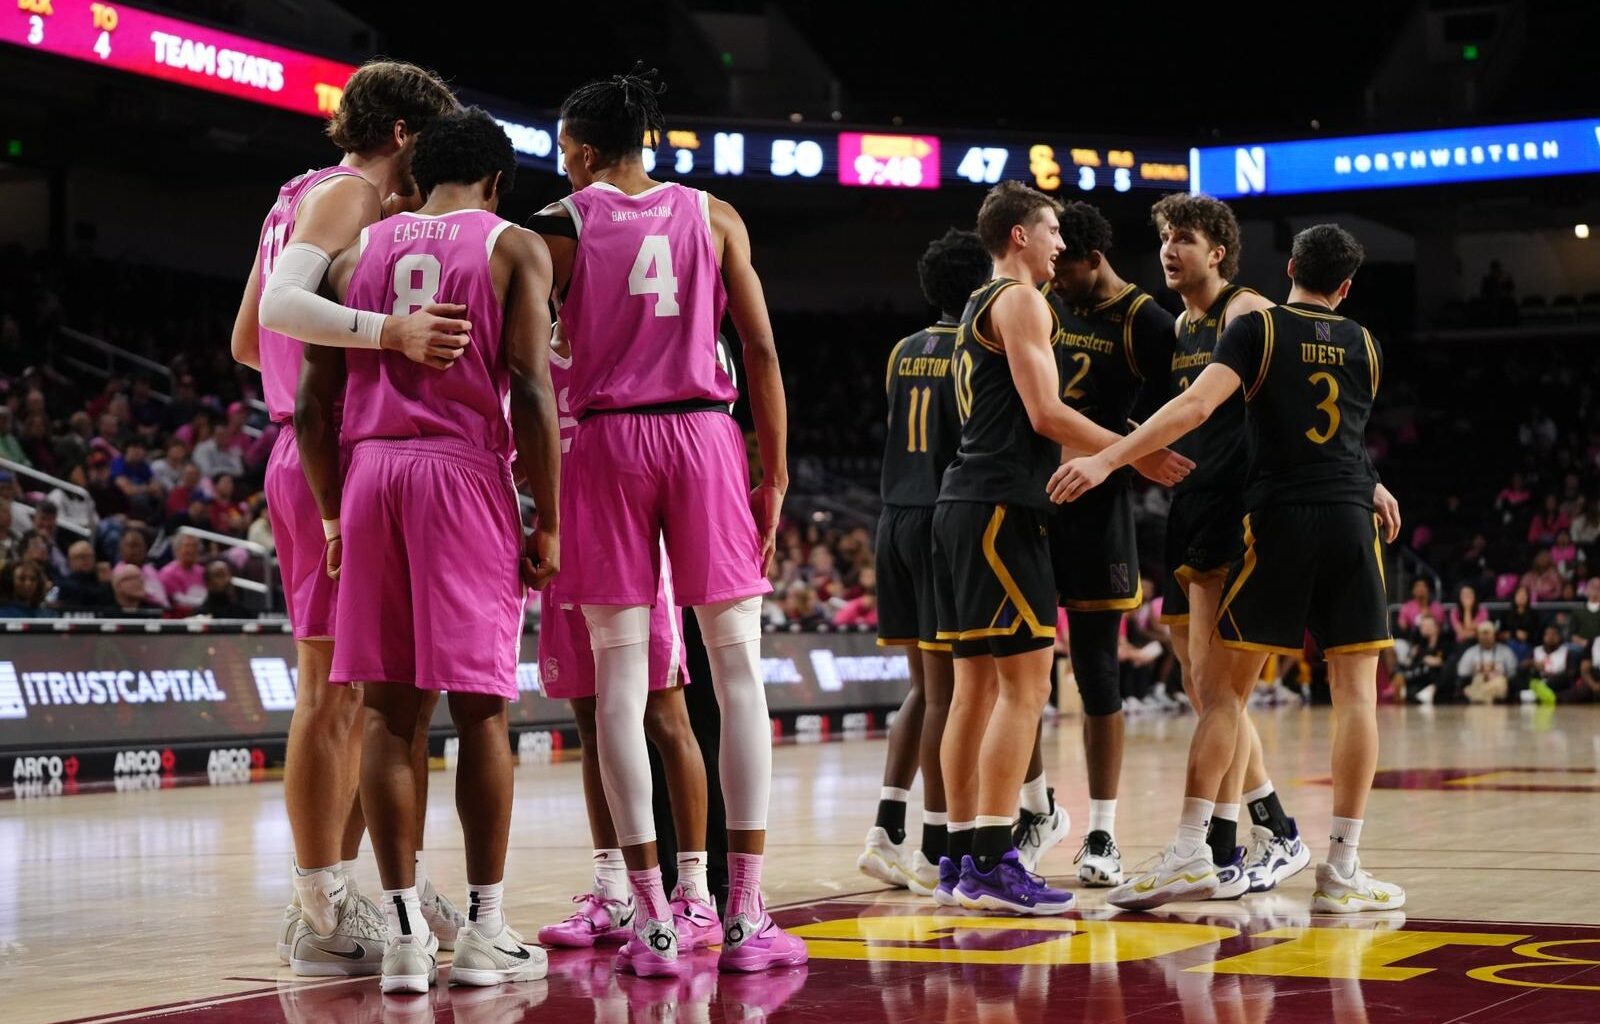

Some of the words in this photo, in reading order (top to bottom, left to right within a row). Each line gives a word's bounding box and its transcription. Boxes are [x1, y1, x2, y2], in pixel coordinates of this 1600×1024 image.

[27, 14, 44, 45] 3
[90, 2, 119, 31] TO
[93, 31, 112, 60] 4
[150, 31, 216, 75] TEAM
[216, 48, 284, 92] STATS
[714, 131, 745, 176] N
[770, 139, 824, 177] 50
[956, 146, 1009, 184] 47
[1234, 146, 1266, 194] N
[1333, 140, 1560, 175] NORTHWESTERN
[1077, 165, 1096, 191] 3
[393, 220, 447, 243] EASTER
[392, 254, 442, 317] 8
[627, 234, 680, 317] 4
[898, 356, 951, 378] CLAYTON
[1300, 342, 1346, 367] WEST
[1063, 351, 1092, 400] 2
[906, 385, 932, 453] 11
[1304, 371, 1342, 445] 3
[13, 756, 63, 779] ARCO
[114, 750, 161, 774] ARCO
